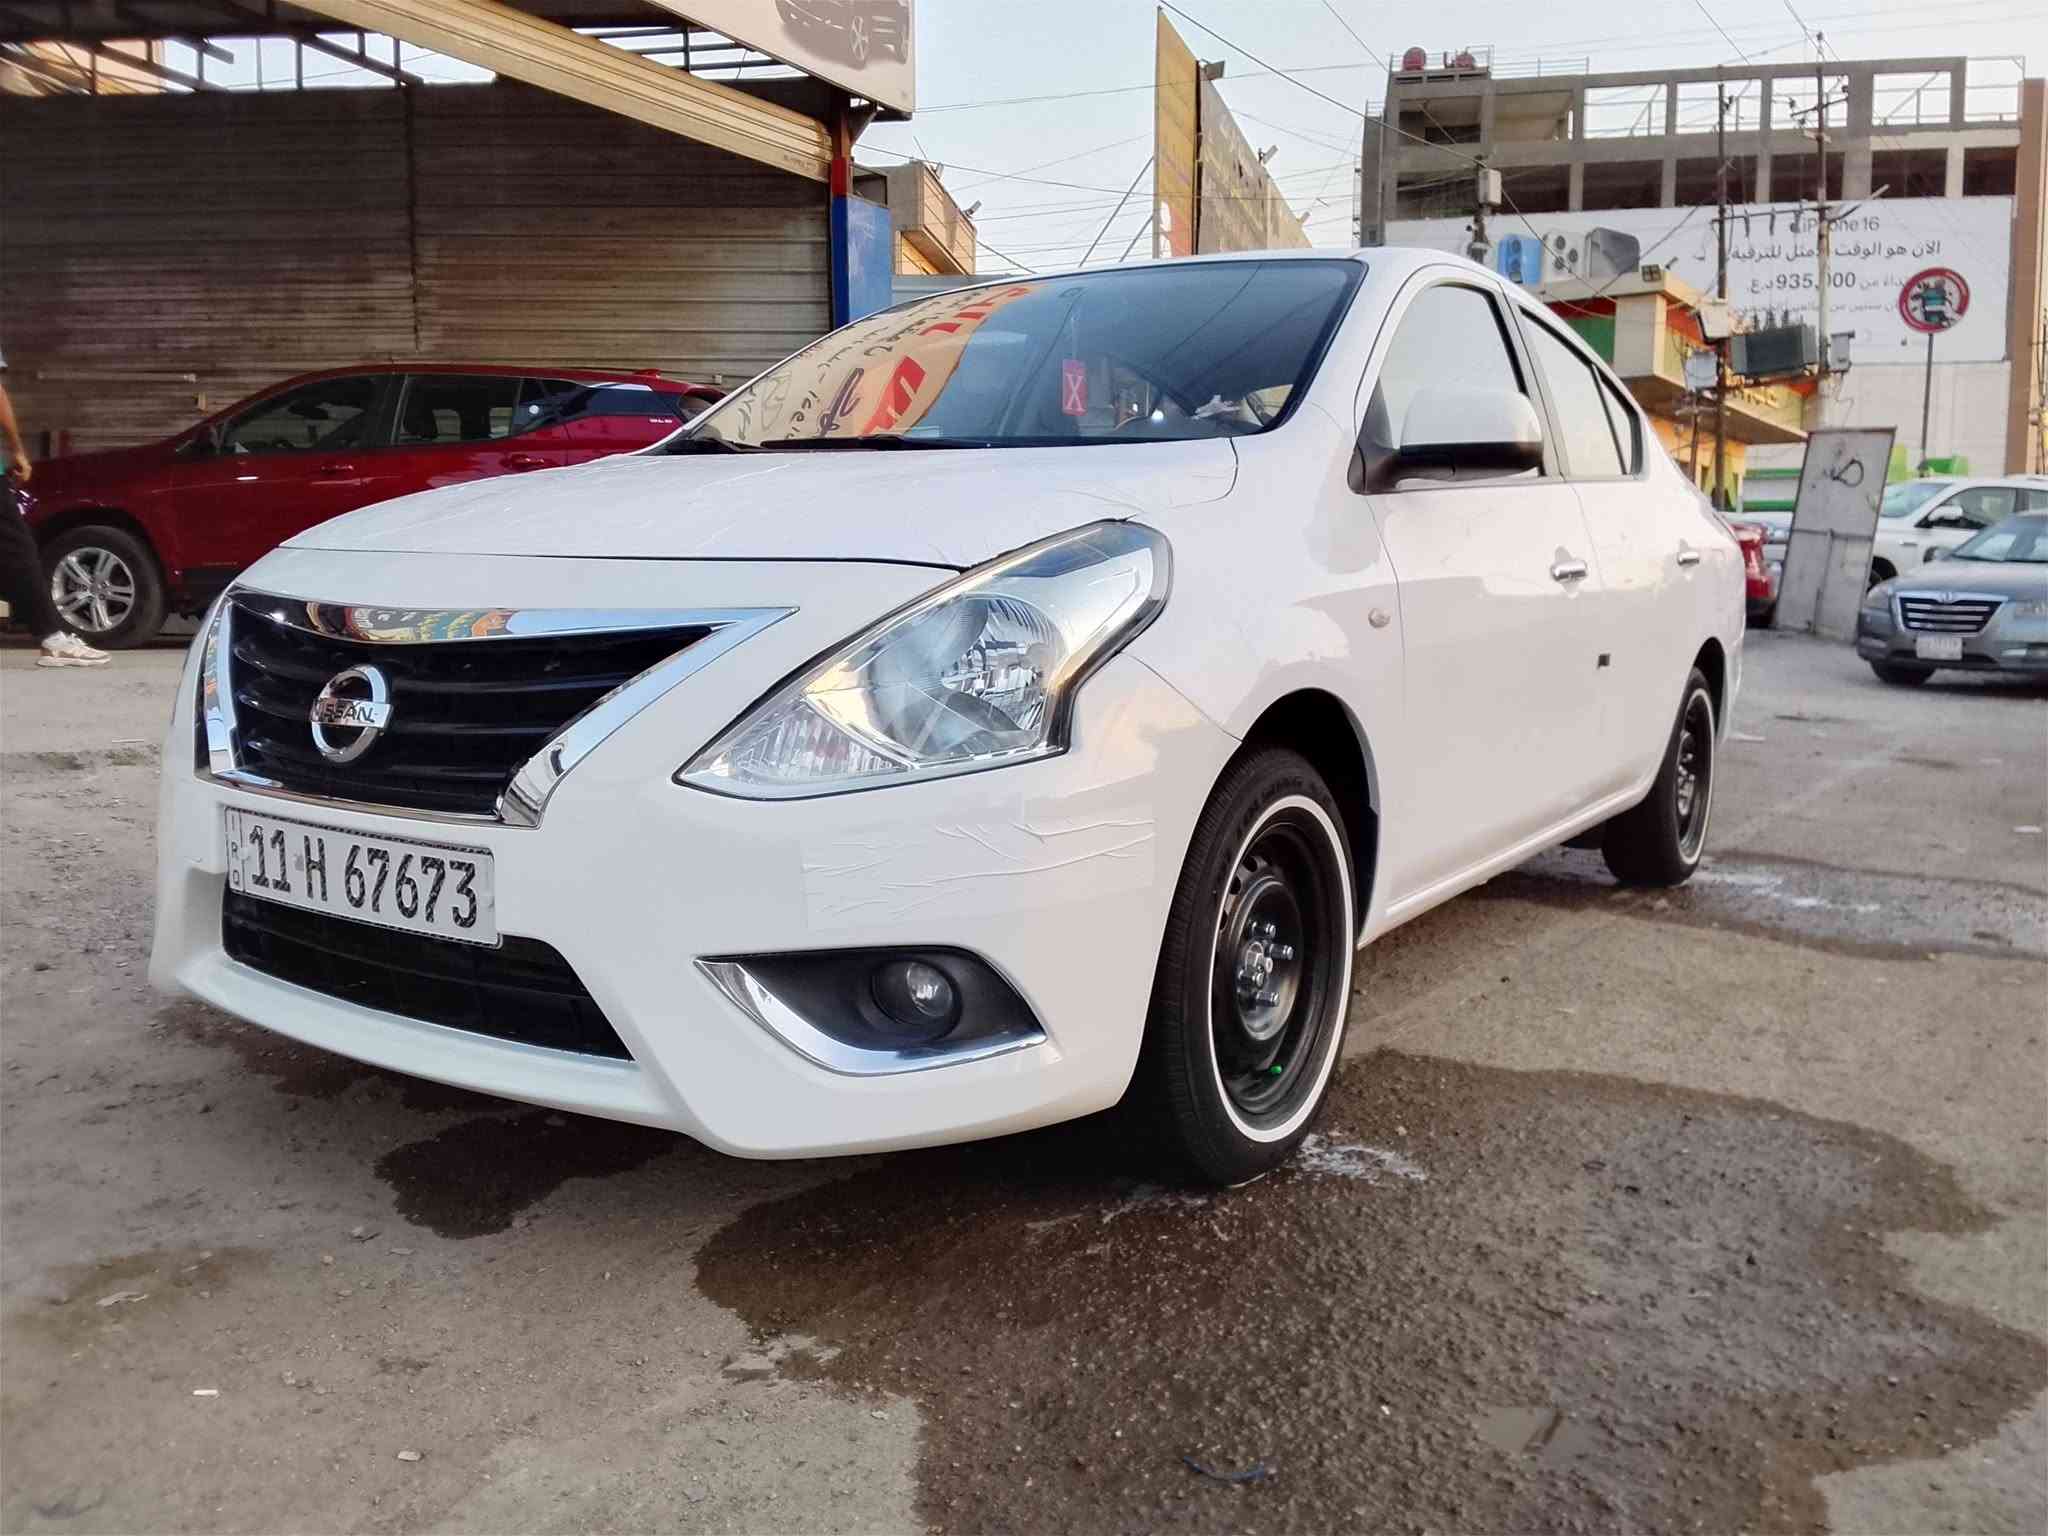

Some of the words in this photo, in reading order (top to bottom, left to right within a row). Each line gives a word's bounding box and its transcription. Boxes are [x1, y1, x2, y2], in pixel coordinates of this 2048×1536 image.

[1803, 215, 1858, 232] iPone
[1863, 216, 1881, 231] 16
[249, 824, 291, 892] 11
[303, 835, 328, 902] H
[344, 844, 478, 929] 67673
